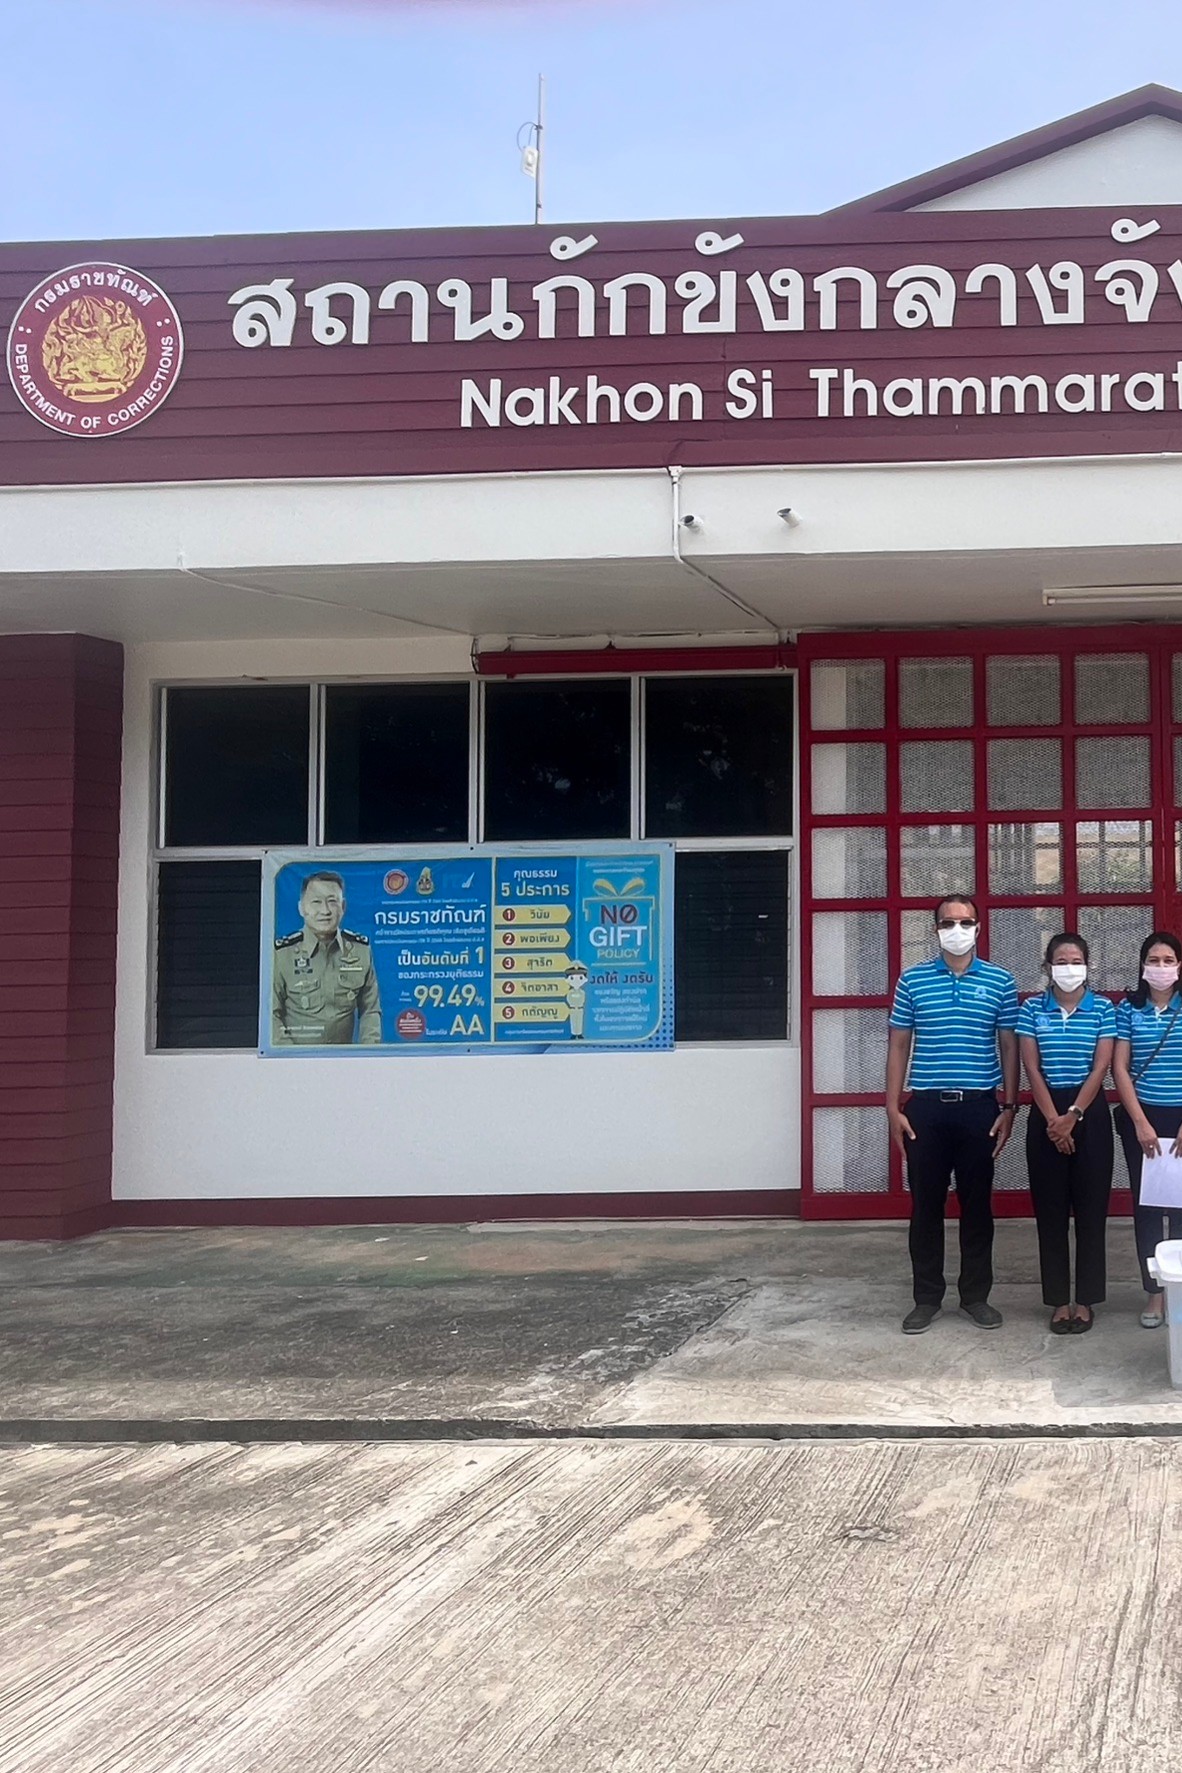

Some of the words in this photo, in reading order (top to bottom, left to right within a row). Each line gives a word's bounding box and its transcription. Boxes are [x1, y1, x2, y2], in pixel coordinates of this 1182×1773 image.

[34, 268, 158, 313] กรมราชทัณฑ์
[15, 343, 76, 426] DEPARTMENT
[80, 416, 101, 429] OF
[107, 335, 174, 426] CORRECTIONS
[459, 375, 705, 428] Nakhon
[725, 367, 774, 421] Si
[513, 869, 557, 881] คุณธรรม
[501, 882, 510, 897] 5
[516, 881, 570, 897] ประการ
[374, 904, 487, 925] กรมราชทัณฑ์
[530, 909, 550, 919] วินัย
[506, 935, 512, 944] 2
[520, 932, 560, 944] พอเพียง
[589, 926, 648, 947] GIFT
[398, 947, 469, 966] เป็นอันดับที่
[475, 946, 484, 964] 1
[597, 948, 640, 959] POLICY
[506, 959, 512, 968] 3
[527, 957, 552, 970] สุจริต
[398, 969, 484, 980] ของกระทรวงยุติธรรม
[589, 971, 618, 984] งดให้
[623, 972, 653, 984] งดรับ
[505, 983, 512, 992] 4
[521, 981, 558, 992] จิตอาสา
[505, 1008, 512, 1018] 5
[522, 1007, 558, 1019] กตัญญู
[450, 1014, 485, 1036] AA
